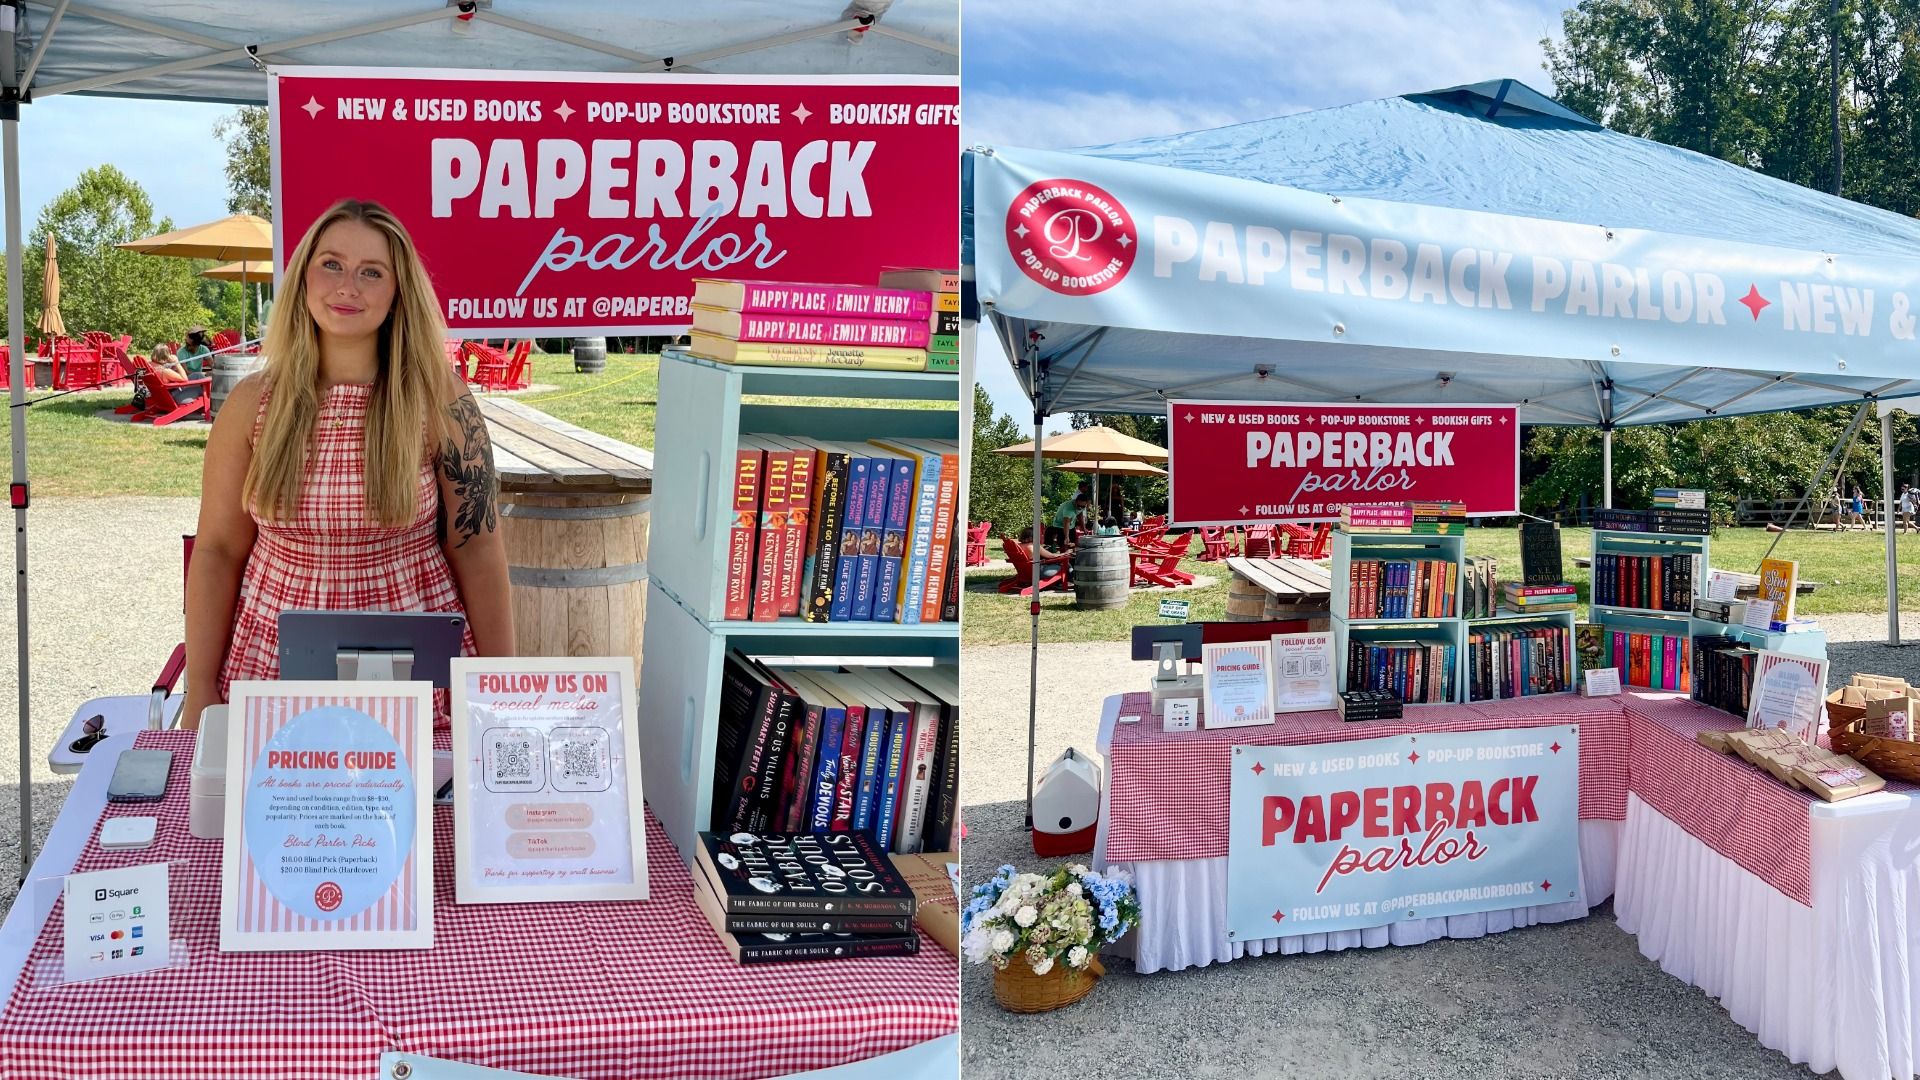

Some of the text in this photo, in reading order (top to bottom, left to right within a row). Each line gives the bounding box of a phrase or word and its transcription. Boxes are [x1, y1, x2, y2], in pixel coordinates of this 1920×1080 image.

[337, 97, 542, 122] NEW & USED BOOKS
[587, 101, 780, 124] POP-UP BOOKSTORE
[830, 103, 959, 125] BOOKISH GIFTS
[431, 138, 877, 218] PAPERBACK
[1020, 187, 1124, 227] PAPERBACK PARLOR
[515, 202, 788, 297] parlor
[1020, 248, 1124, 288] POP-UP BOOKSTORE
[1153, 215, 1727, 326] PAPERBACK PARLOR
[448, 298, 528, 319] FOLLOW
[533, 297, 557, 318] US
[563, 297, 587, 317] AT
[752, 289, 910, 314] HAPPY PLACE EMILY HENRY
[1780, 280, 1917, 341] NEW &
[749, 320, 907, 344] HAPPY PLACE EMILY HENRY
[825, 348, 864, 366] Jennette McCurdy
[1201, 413, 1300, 425] NEW & USED BOOKS
[1321, 415, 1411, 426] POP-UP BOOKSTORE
[1432, 415, 1492, 425] BOOKISH GIFTS
[1246, 431, 1455, 468] PAPERBACK
[737, 459, 756, 508] REEL
[768, 460, 788, 509] REEL
[789, 456, 809, 505] REEL
[1288, 460, 1416, 504] parlor
[824, 477, 839, 541] BEFORE LET GO
[1255, 505, 1294, 515] FOLLOW
[1297, 504, 1310, 514] US
[1312, 503, 1323, 513] AT
[780, 527, 795, 598] KENNEDY RYAN
[909, 484, 936, 610] BEACH READ EMILY HENRY
[926, 480, 953, 605] BOOK LOVERS EMILY HENRY
[730, 531, 744, 602] KENNEDY RYAN
[760, 532, 774, 604] KENNEDY RYAN
[819, 543, 832, 590] KENNEDY RYAN
[839, 559, 850, 602] JULIE SOTO
[858, 558, 869, 601] JULIE SOTO
[880, 560, 893, 603] JULIE SOTO
[479, 674, 608, 693] FOLLOW US ON
[1216, 663, 1260, 672] PRICING GUIDE
[489, 694, 599, 711] social media
[749, 691, 778, 774] SUCH SHARP TEETH
[760, 700, 792, 799] ALL OF US VILLAINS
[865, 731, 880, 776] HOUSEMAID
[916, 732, 927, 761] WATCHING
[926, 719, 937, 753] HOUSEMAID
[1427, 743, 1544, 763] POP-UP BOOKSTORE
[268, 751, 396, 770] PRICING GUIDE
[888, 733, 903, 778] HOUSEMAID
[1273, 752, 1400, 777] NEW & USED BOOKS
[814, 759, 836, 828] Truly DEVIOUS
[835, 789, 852, 821] STAIR
[1262, 775, 1539, 847] PAPERBACK
[739, 845, 774, 879] THE
[763, 834, 816, 892] FABRIC
[798, 834, 830, 865] OUR
[824, 834, 886, 893] SOULS
[1315, 818, 1488, 894] parlor
[108, 888, 139, 898] Square
[1292, 881, 1535, 922] FOLLOW US AT @PAPERBACKPARLORBOOKS
